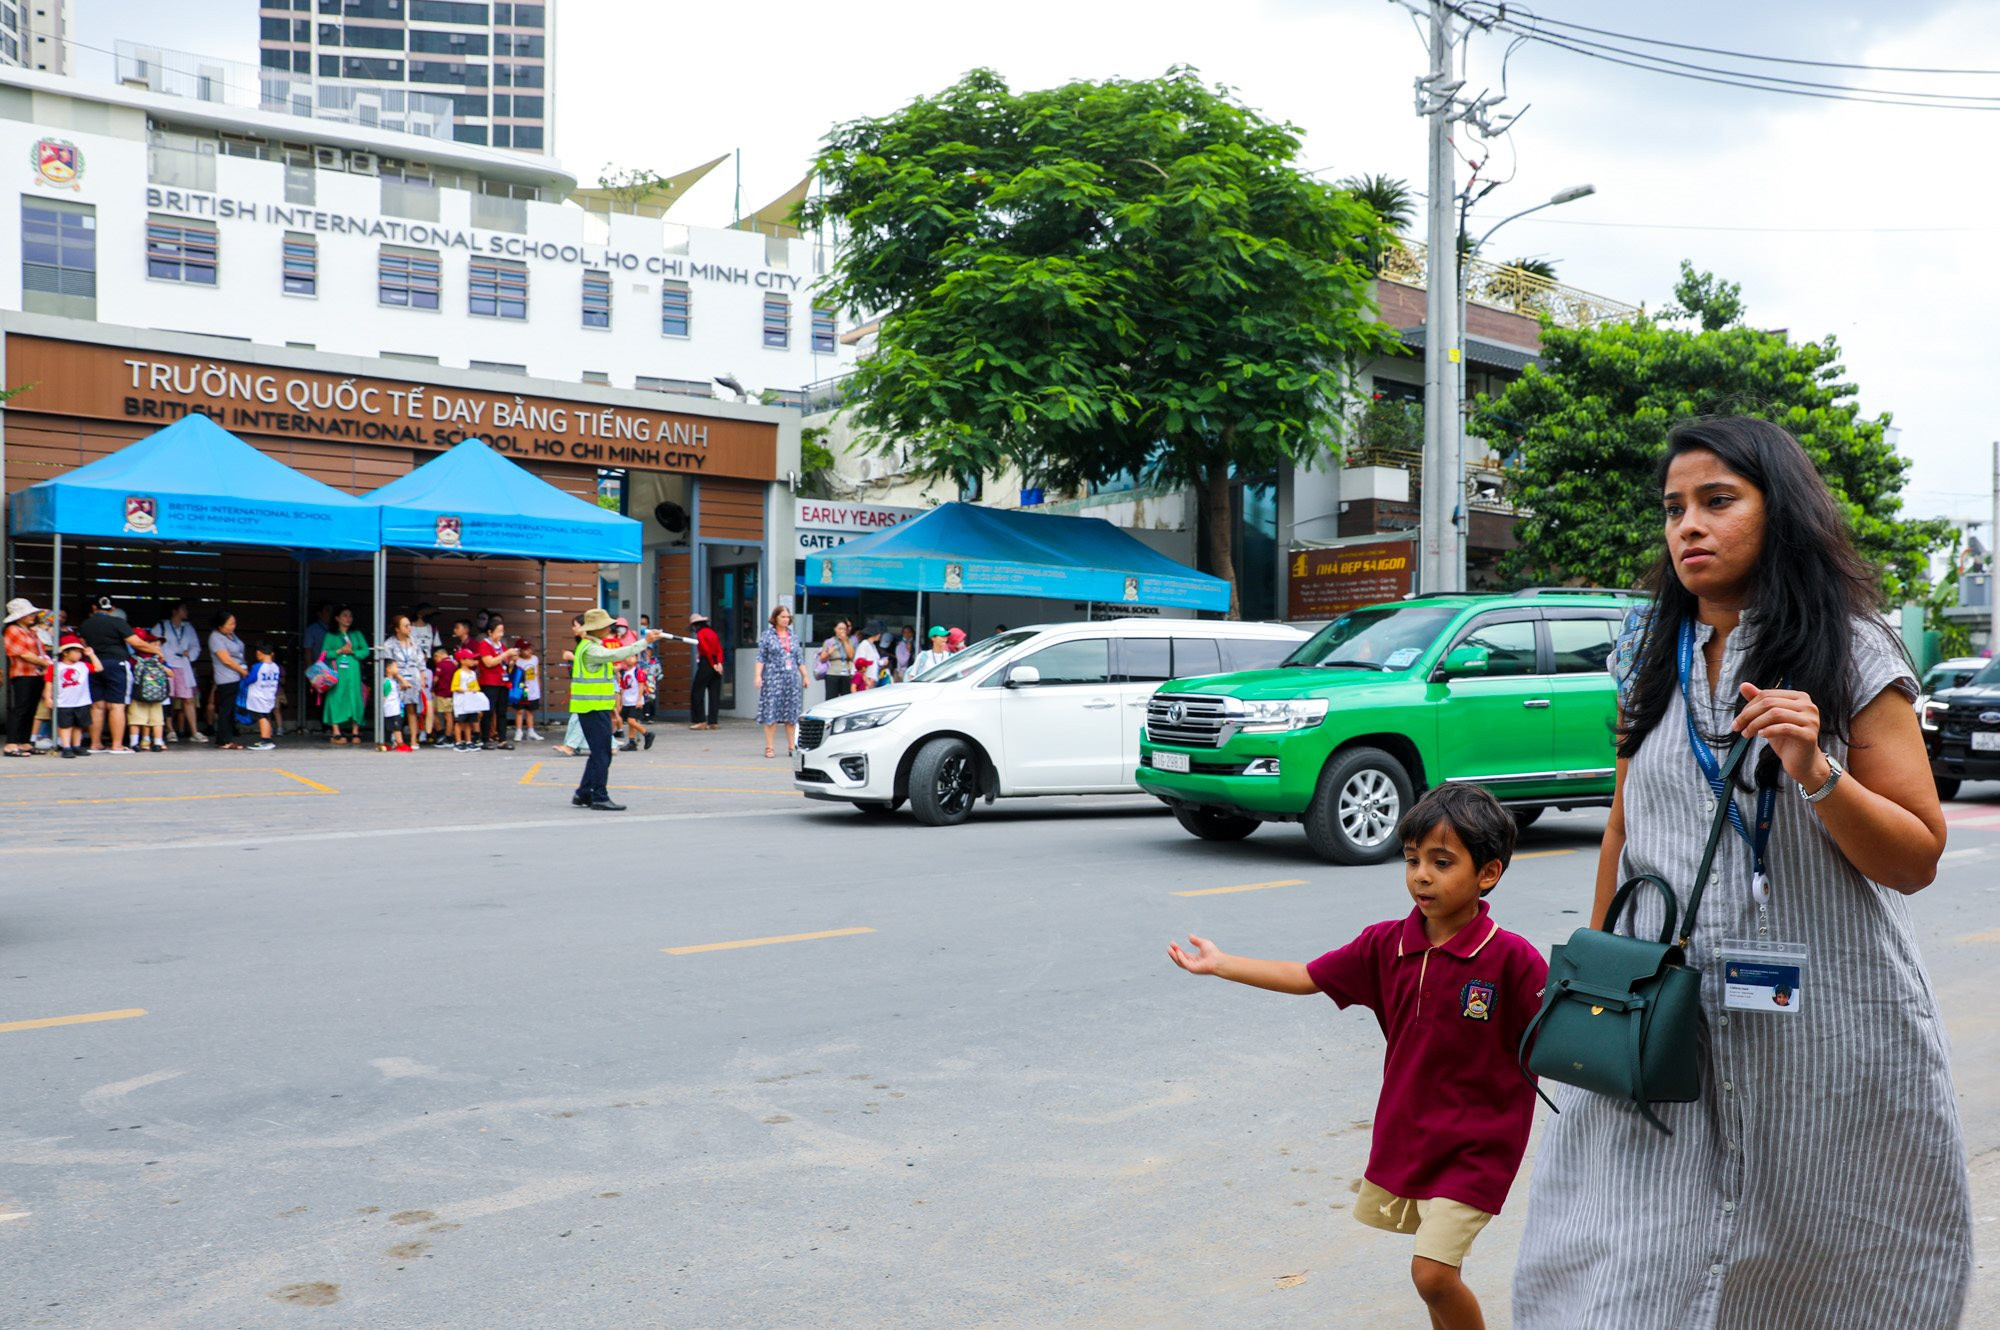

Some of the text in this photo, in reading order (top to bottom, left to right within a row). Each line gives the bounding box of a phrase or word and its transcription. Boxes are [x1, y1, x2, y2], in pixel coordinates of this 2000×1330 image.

[146, 188, 802, 292] BRITISH INTERNATIONAL SCHOOL, HO CHI MINH CITY
[124, 359, 278, 403] TRƯỜNG
[285, 378, 381, 413] QUỐC
[386, 386, 425, 420] TẾ
[493, 396, 568, 433] BẰNG
[574, 408, 650, 442] TIẾNG
[656, 420, 708, 448] ANH
[124, 396, 225, 424] BRITISH
[233, 407, 427, 443] INTERNATIONAL
[534, 438, 565, 457] HO
[571, 442, 602, 460] CHI
[608, 446, 659, 465] MINH
[664, 450, 706, 469] CITY
[168, 502, 333, 521] BRITISH INTERNATIONAL SCHOOL
[168, 512, 184, 521] HO
[237, 516, 260, 525] CITY
[802, 506, 847, 524] EARLY
[850, 510, 896, 527] YEARS
[800, 534, 834, 549] GATE
